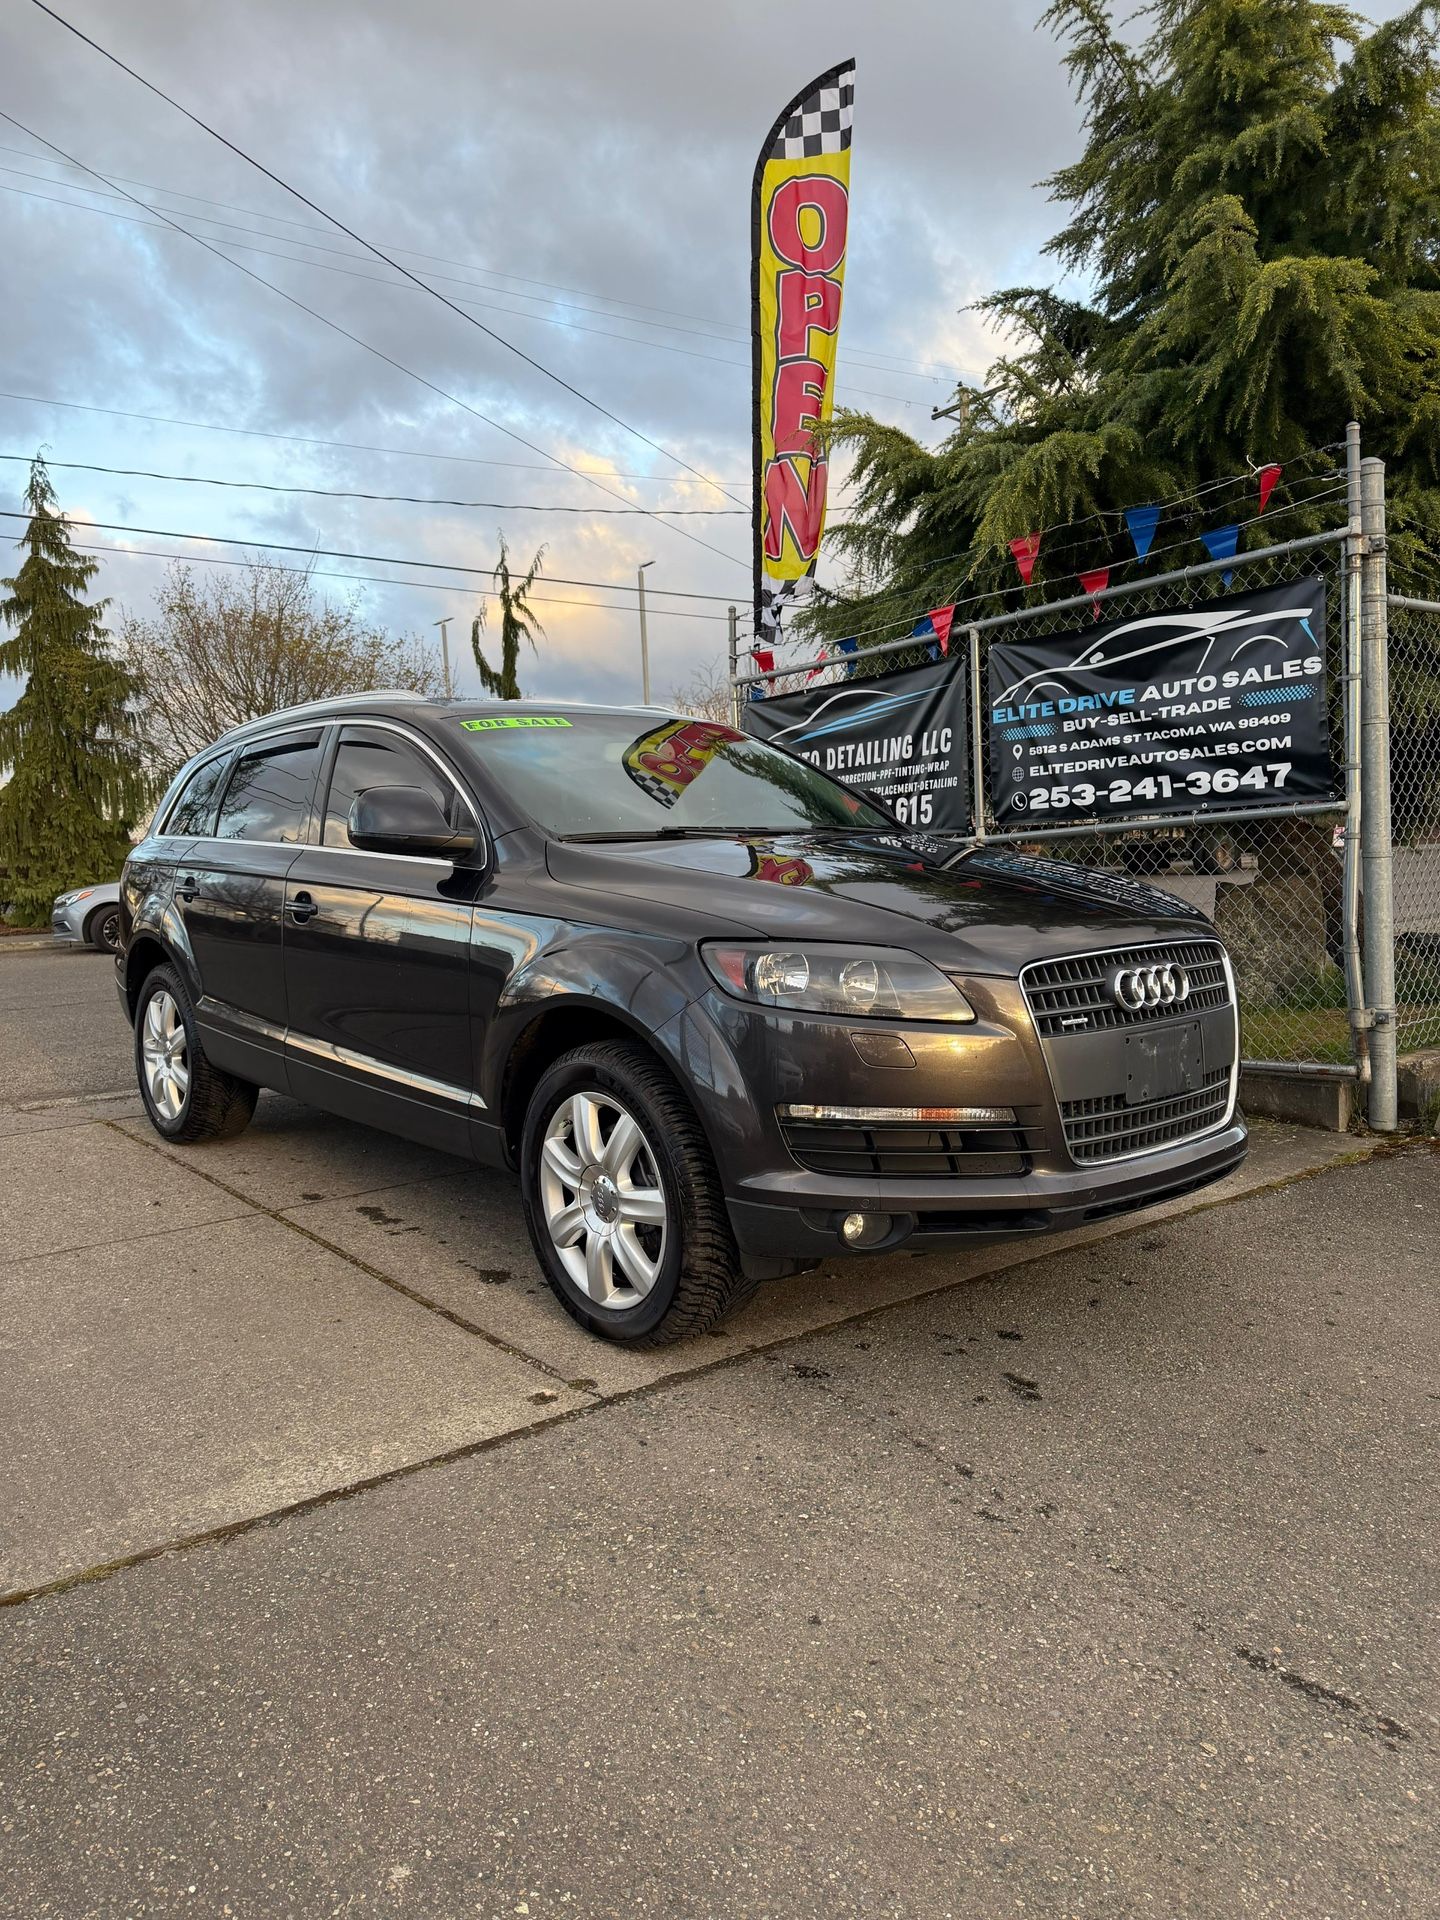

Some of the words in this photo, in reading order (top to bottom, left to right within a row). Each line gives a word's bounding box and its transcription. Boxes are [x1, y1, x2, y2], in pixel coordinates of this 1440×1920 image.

[765, 174, 849, 562] OPEN
[992, 701, 1056, 724] ELITE
[1058, 688, 1136, 715] DRIVE
[1139, 675, 1218, 702] AUTO
[1222, 656, 1322, 689] SALES
[466, 719, 507, 730] FOR
[516, 717, 566, 726] SALE
[1029, 744, 1057, 756] 5812
[1059, 743, 1068, 753] S
[1069, 735, 1121, 751] ADAMS
[1122, 733, 1142, 744] ST
[1144, 725, 1207, 742] TACOMA
[1208, 721, 1236, 734] WA
[1238, 712, 1292, 729] 98409
[1063, 696, 1232, 733] BUY-SELL-TRADE
[826, 734, 913, 771] DETAILING
[921, 727, 953, 757] LLC
[1029, 735, 1292, 777] ELITEDRIVEAUTOSALES.COM
[837, 759, 950, 784] ORRECTION-PPF-TINTING-WRAP
[1029, 762, 1292, 810] 253-241-3647
